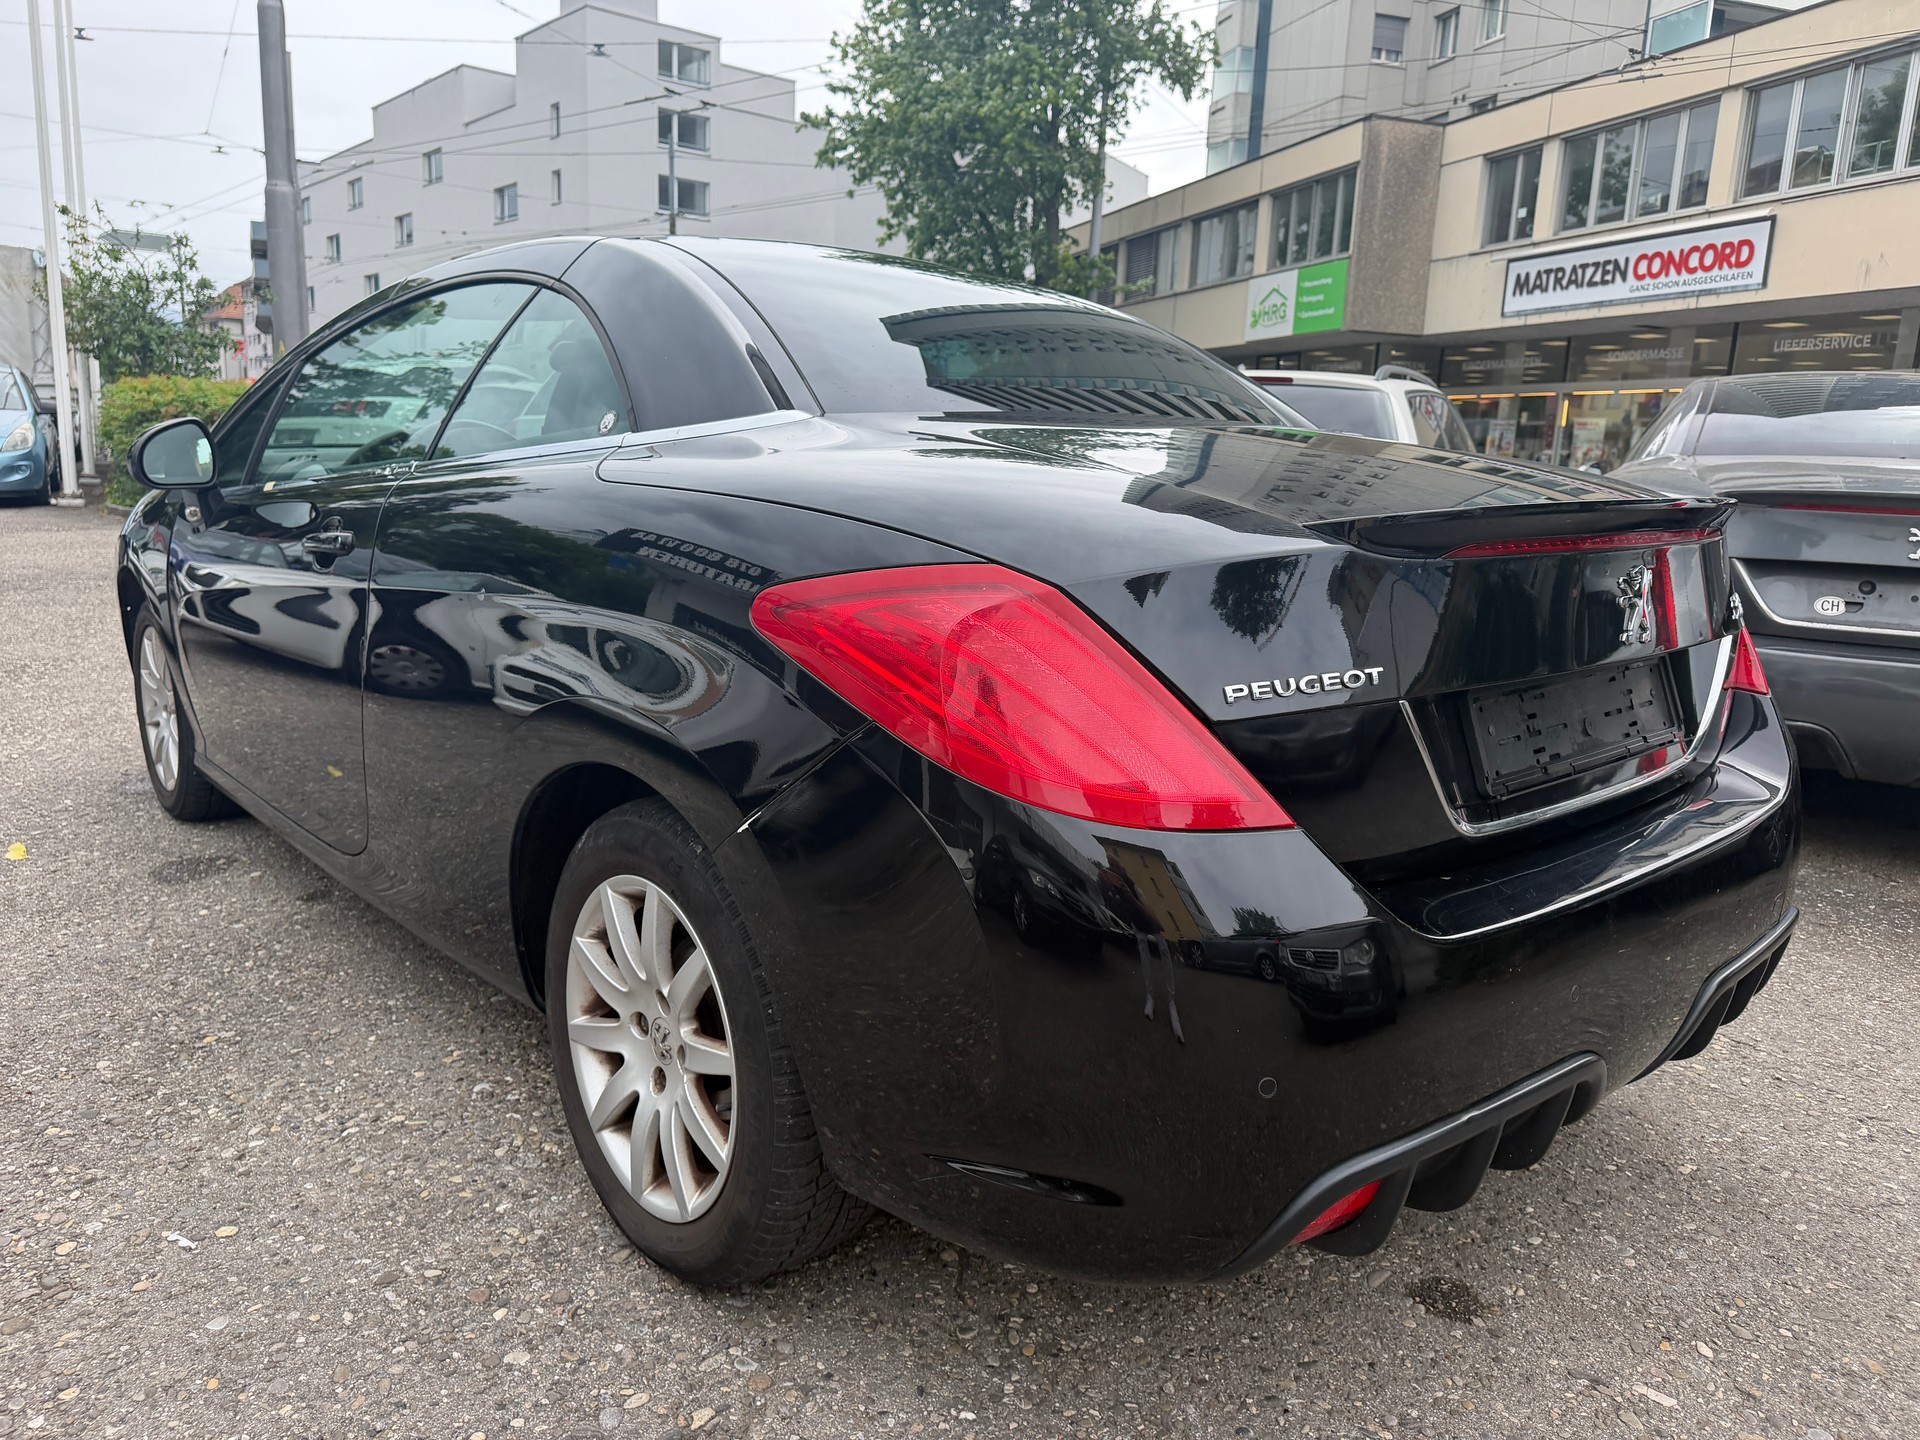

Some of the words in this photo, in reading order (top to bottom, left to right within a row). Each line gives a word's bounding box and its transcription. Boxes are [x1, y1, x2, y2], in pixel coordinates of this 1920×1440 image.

[1512, 256, 1629, 297] MATRATZEN
[1633, 239, 1755, 281] CONCORD
[1629, 282, 1650, 293] GANZ
[1262, 302, 1287, 322] HRG
[1821, 600, 1840, 611] CH
[1224, 667, 1384, 704] PEUGEOT
